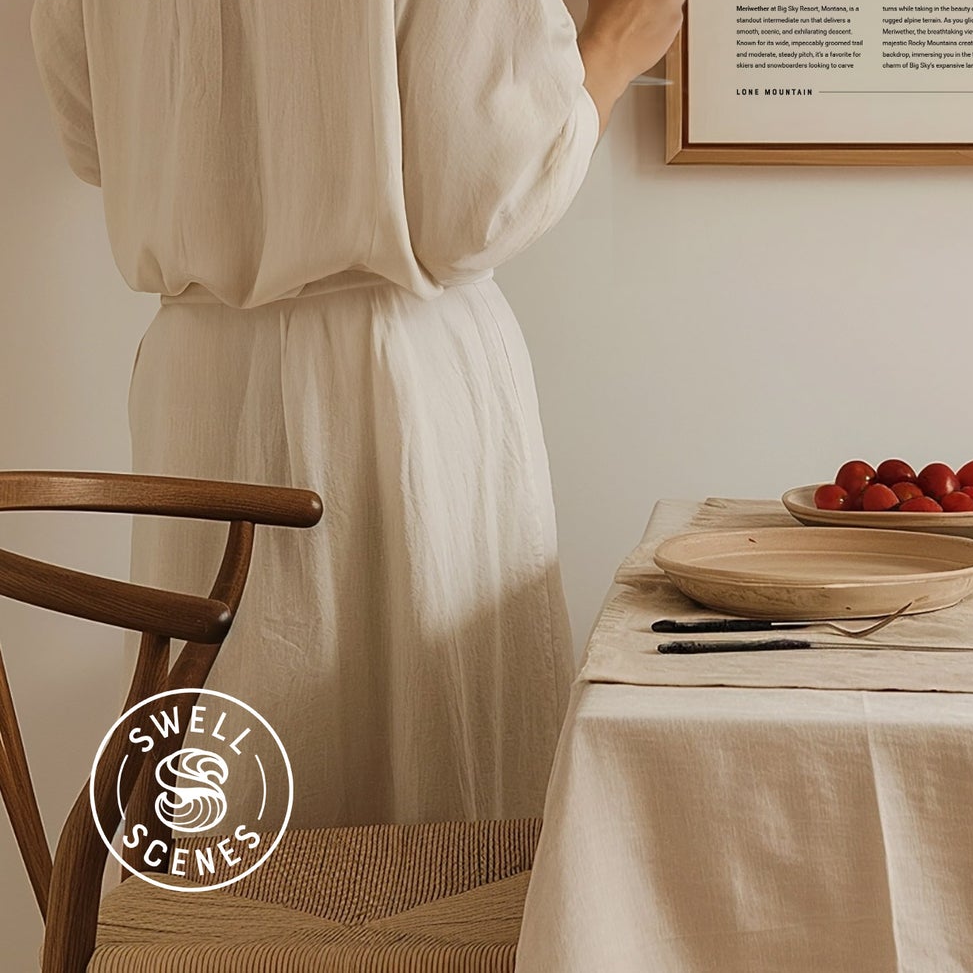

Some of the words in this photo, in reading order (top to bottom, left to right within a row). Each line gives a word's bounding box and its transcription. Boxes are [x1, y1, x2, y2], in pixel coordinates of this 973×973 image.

[778, 5, 787, 13] Big
[788, 5, 798, 13] Sky
[882, 17, 903, 25] rugged
[794, 28, 827, 36] exhilarating
[927, 28, 963, 36] breathtaking
[779, 51, 797, 59] steady
[798, 51, 814, 59] pitch,
[882, 51, 910, 59] backdrop,
[912, 51, 942, 59] immersing
[808, 62, 830, 70] looking
[910, 62, 919, 70] Big
[920, 62, 935, 70] Sky's
[936, 62, 964, 70] expansive
